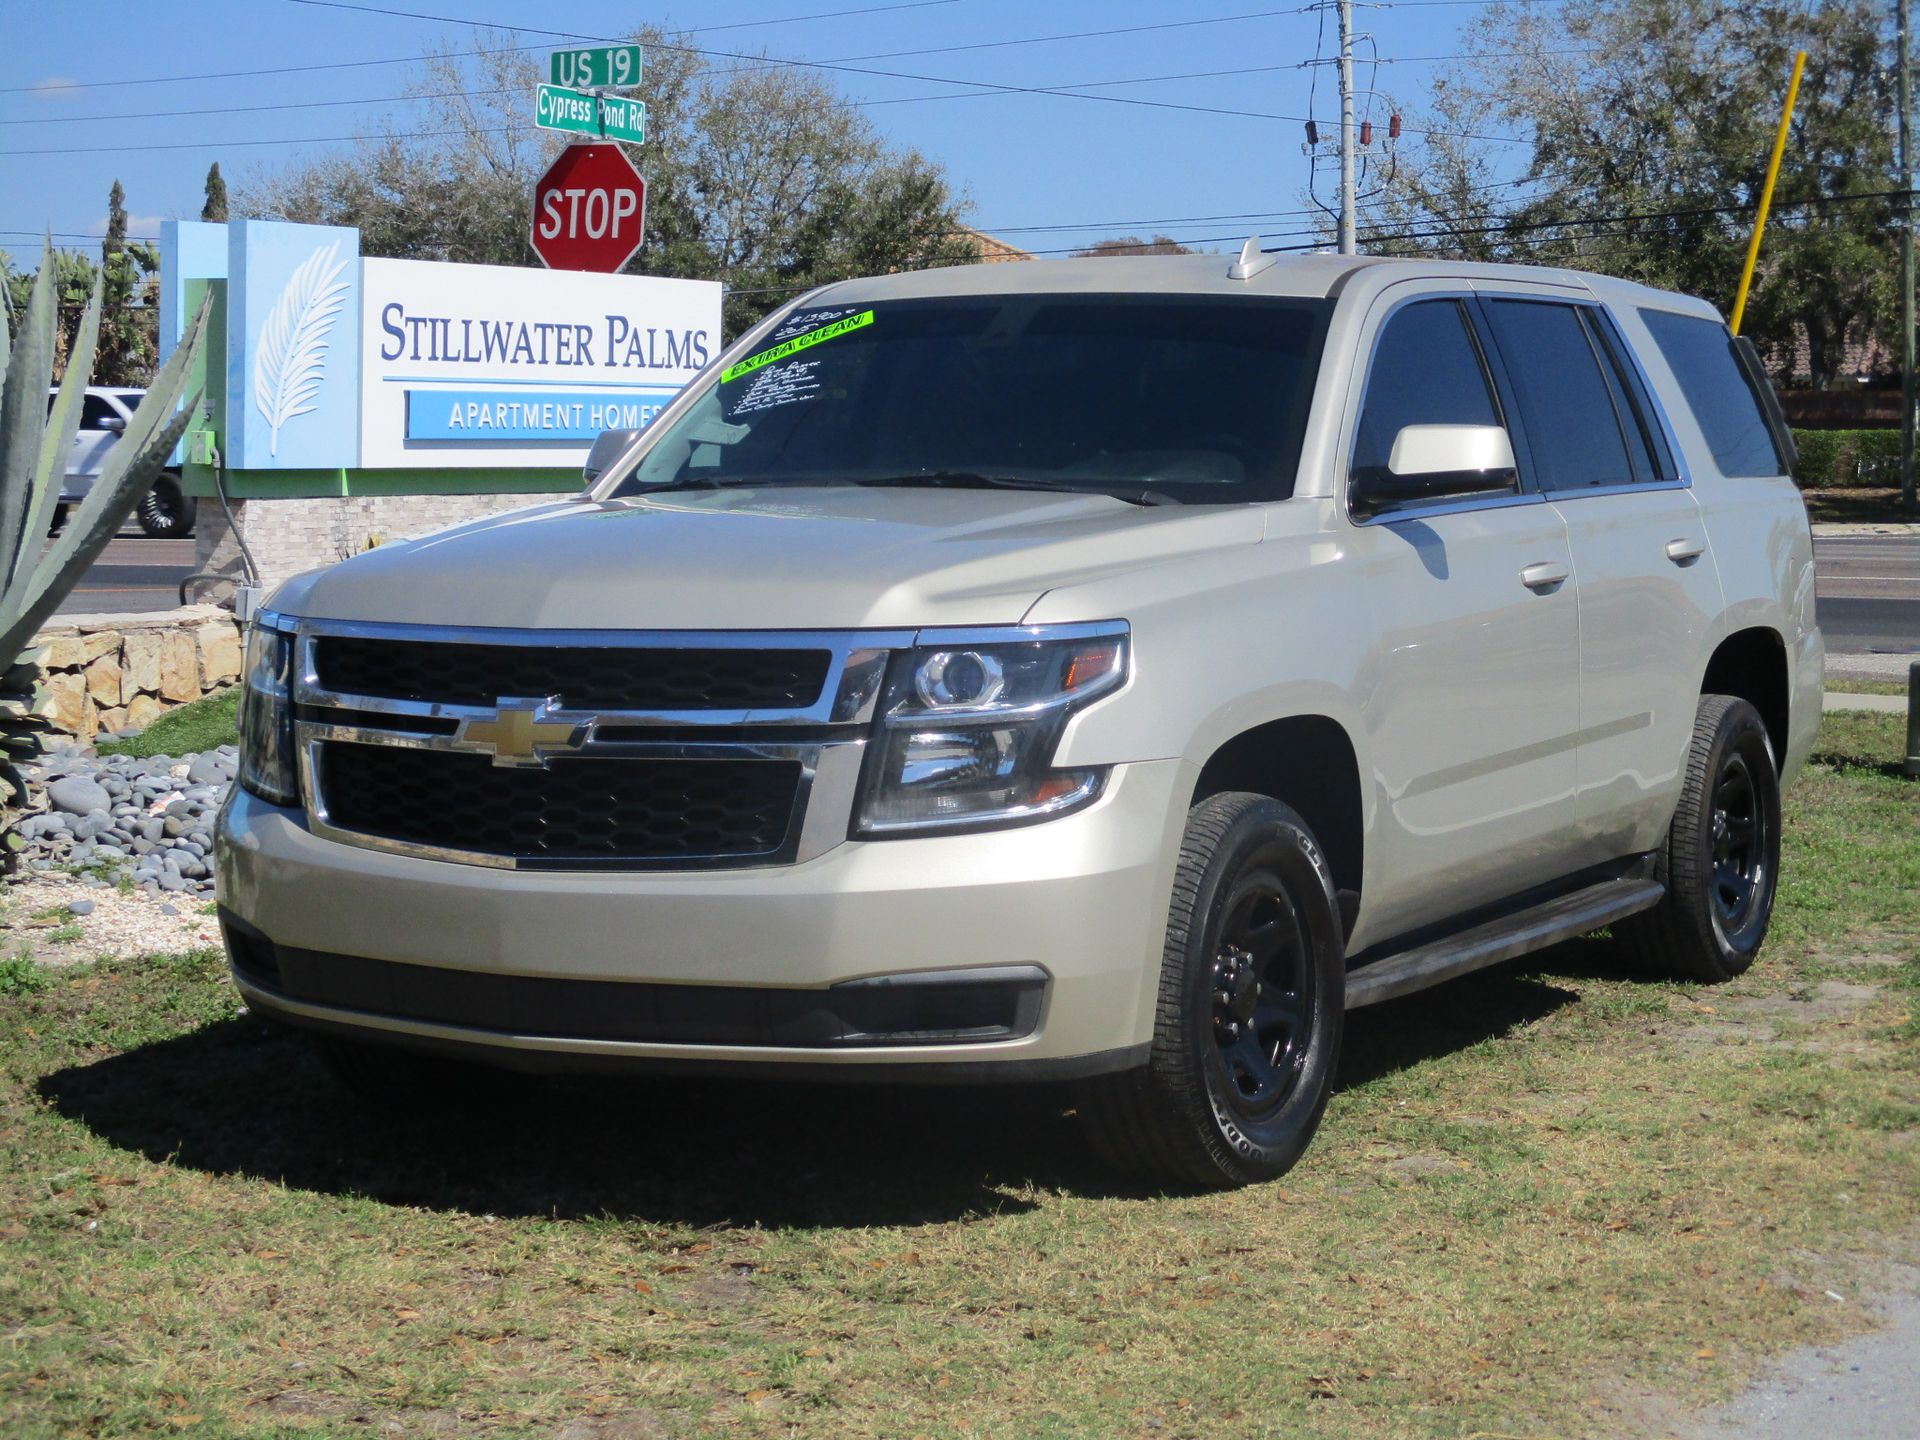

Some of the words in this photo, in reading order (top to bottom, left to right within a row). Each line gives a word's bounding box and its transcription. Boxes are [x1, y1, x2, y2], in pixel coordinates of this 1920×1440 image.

[559, 51, 593, 87] US
[606, 48, 631, 85] 19
[539, 88, 591, 125] Cypress
[629, 101, 643, 132] Rd
[539, 188, 637, 240] STOP
[381, 302, 595, 367] STILLWATER
[604, 315, 708, 370] PALMS
[730, 341, 796, 377] EXTRA
[798, 314, 865, 347] CLEAN
[448, 402, 584, 431] APARTMENT
